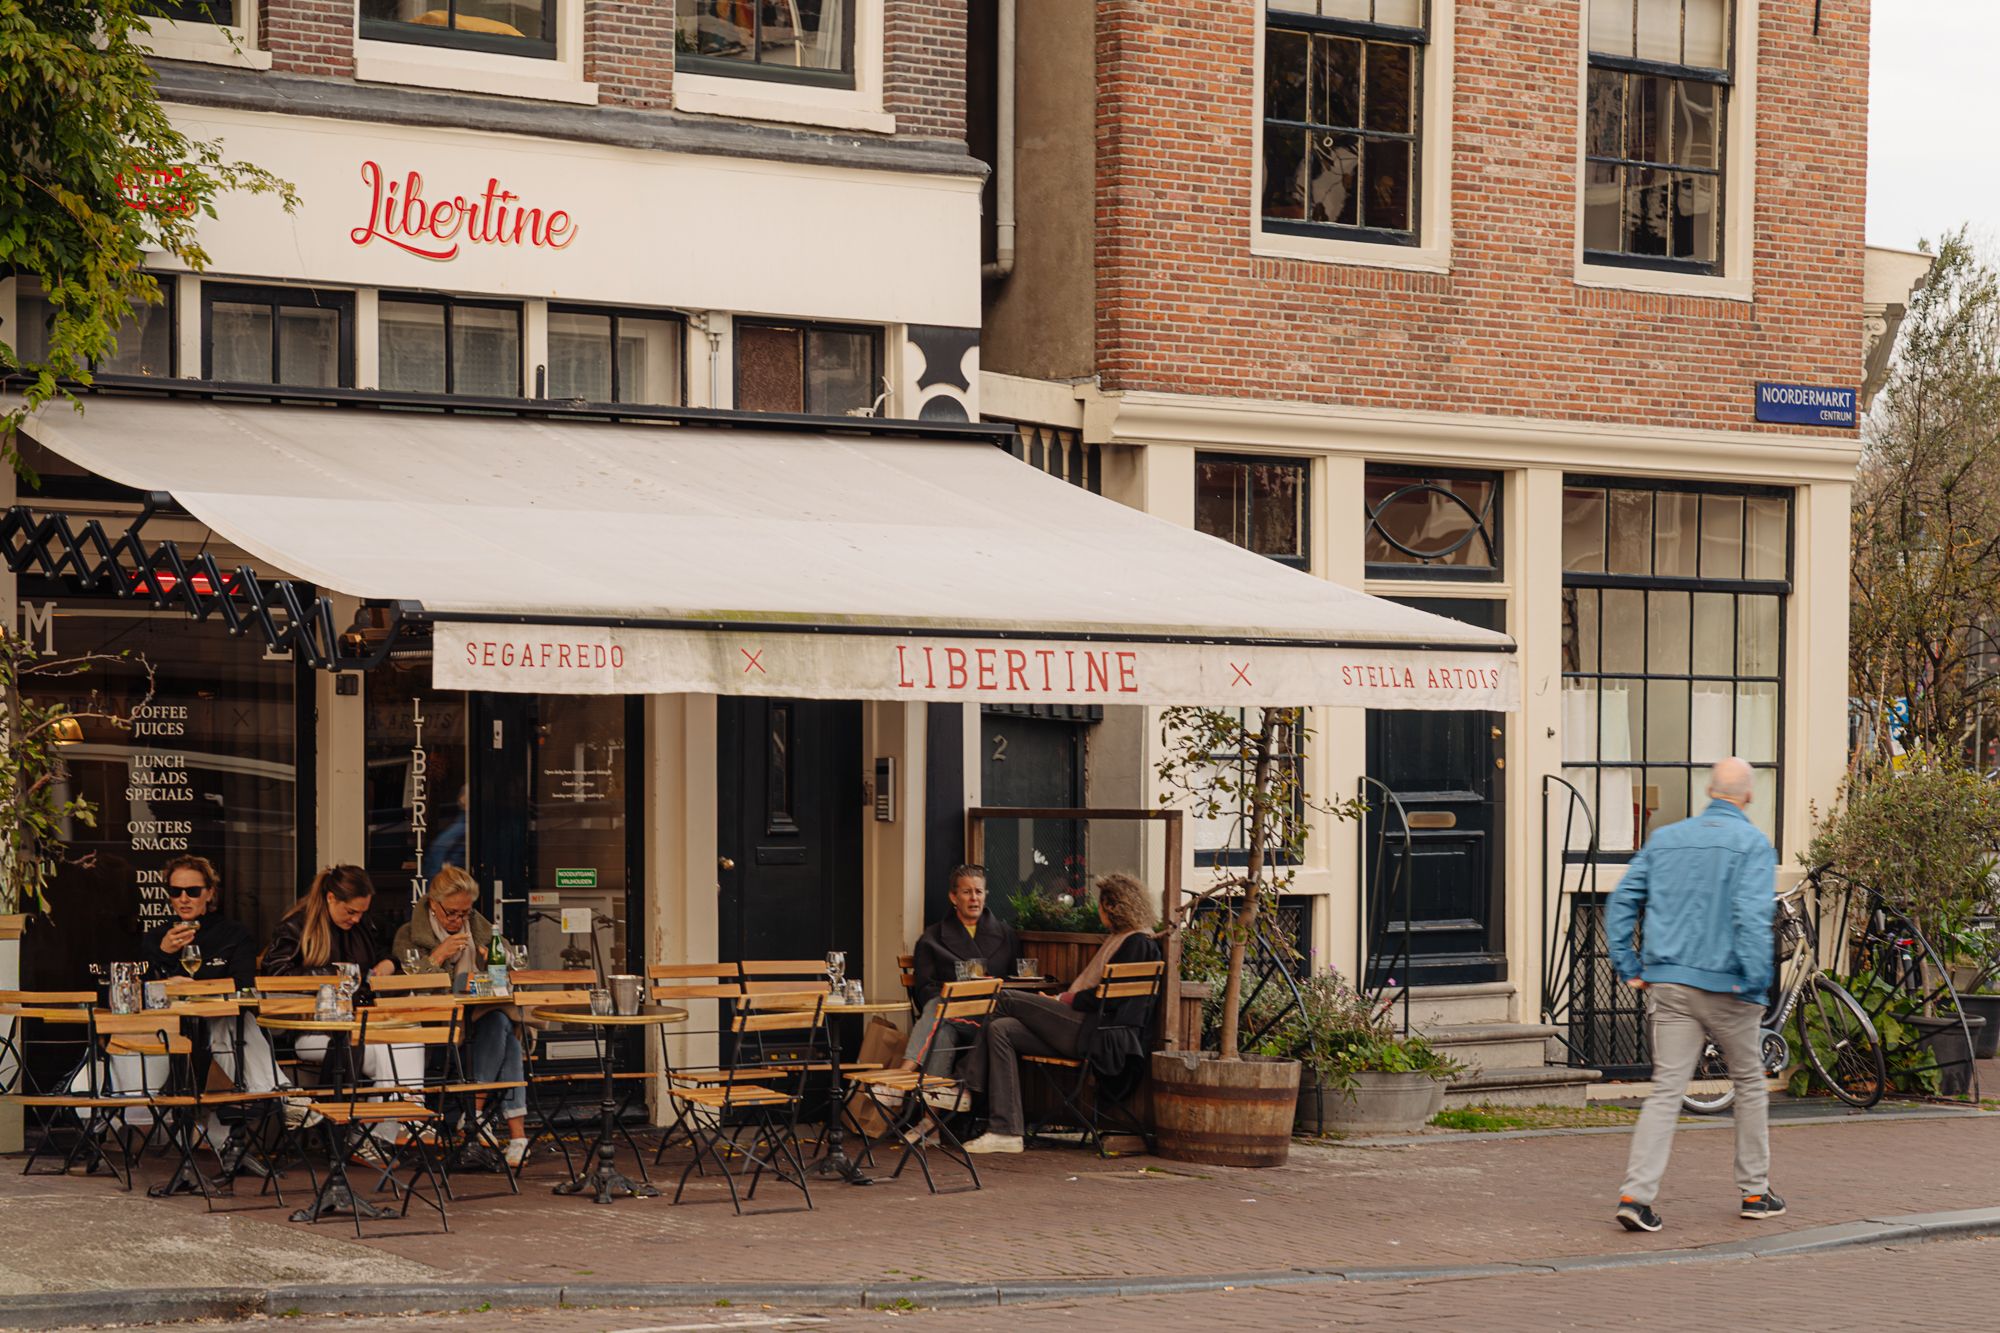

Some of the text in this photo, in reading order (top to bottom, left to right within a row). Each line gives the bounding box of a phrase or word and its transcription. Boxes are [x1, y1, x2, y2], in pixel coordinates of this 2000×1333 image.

[350, 160, 579, 262] Libertine
[1762, 387, 1852, 408] NOORDERMARKT
[1820, 410, 1853, 421] CENTRUM
[466, 642, 625, 668] SEGAFREDO
[896, 645, 1139, 693] LIBERTINE
[1341, 665, 1416, 689] STELLA
[1428, 668, 1499, 690] ARTOIS
[131, 705, 188, 719] COFFEE
[134, 722, 185, 738] JUICES
[992, 735, 1008, 760] 2
[135, 755, 185, 768] LUNCH
[131, 771, 188, 785] SALADS
[125, 787, 194, 801] SPECIALS
[411, 697, 428, 908] LIBERTIN
[127, 820, 192, 834] OYSTERS
[131, 837, 188, 851] SNACKS
[136, 869, 168, 884] DIN
[139, 886, 171, 900] WIN
[139, 902, 178, 917] MEA
[142, 919, 169, 933] FIS
